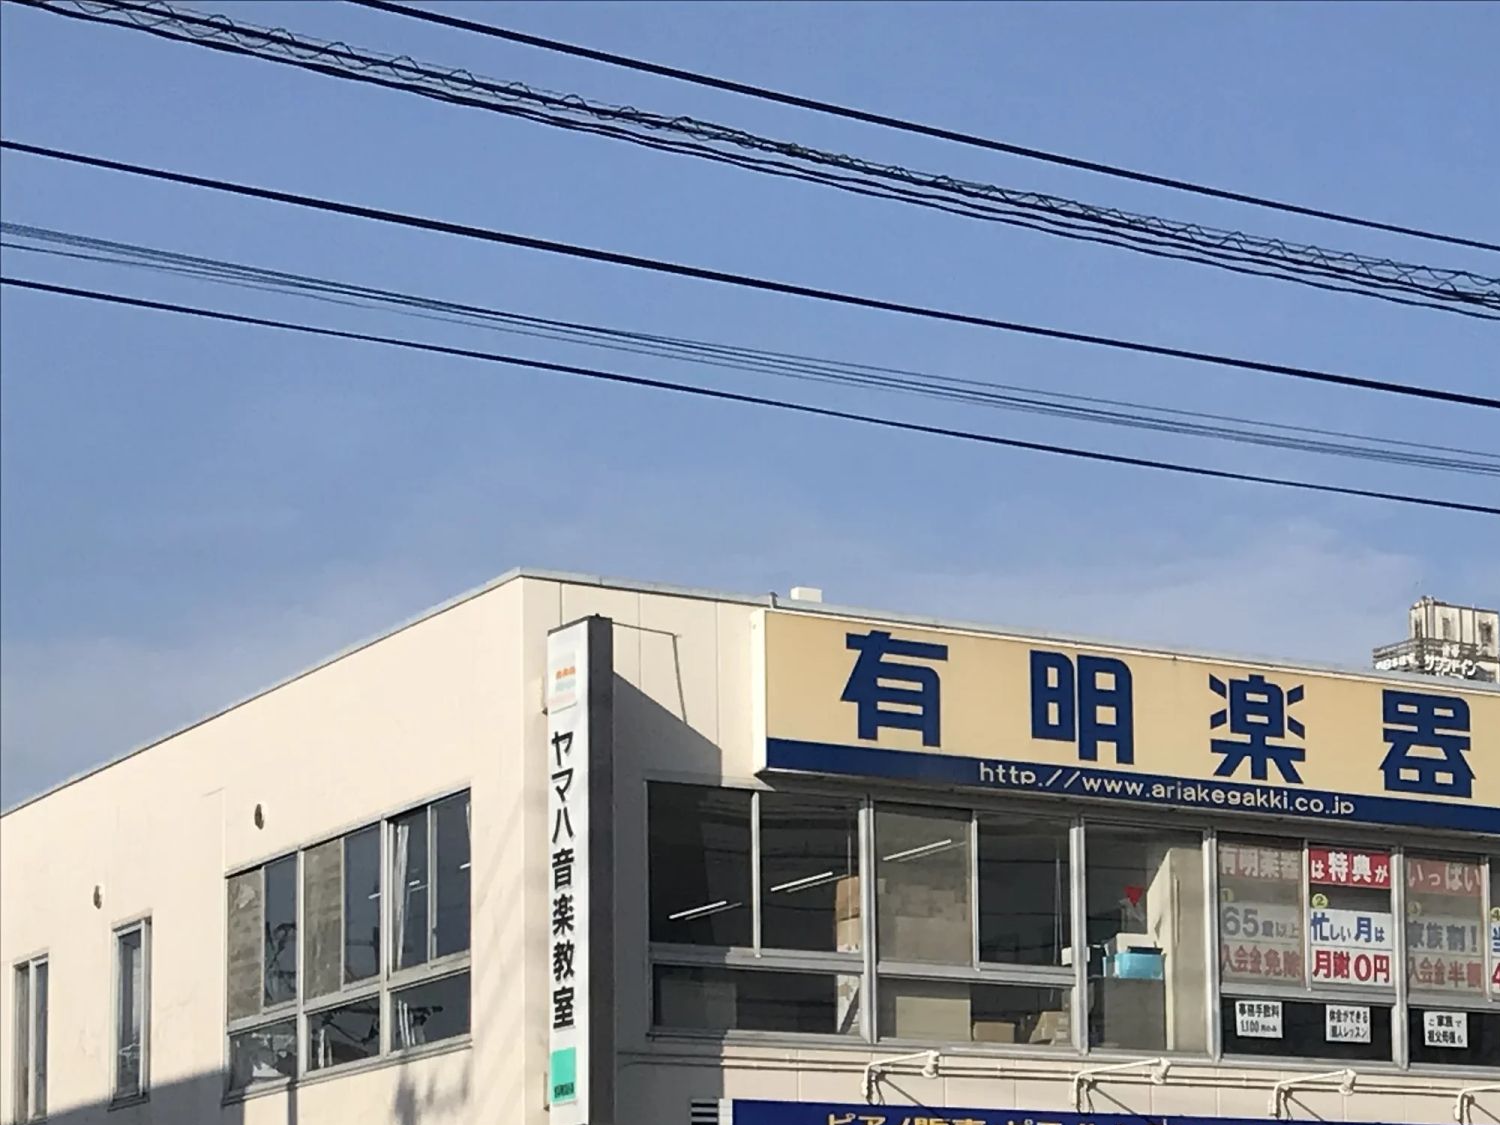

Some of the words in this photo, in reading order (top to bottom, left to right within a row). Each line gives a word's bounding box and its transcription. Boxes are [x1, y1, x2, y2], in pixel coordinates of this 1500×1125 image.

[840, 630, 1477, 798] 有明楽器
[550, 731, 575, 1029] ヤマハ音楽教室
[1310, 851, 1389, 883] は特典が
[1407, 861, 1481, 891] いっぱい
[1311, 911, 1385, 943] 忙しい月は
